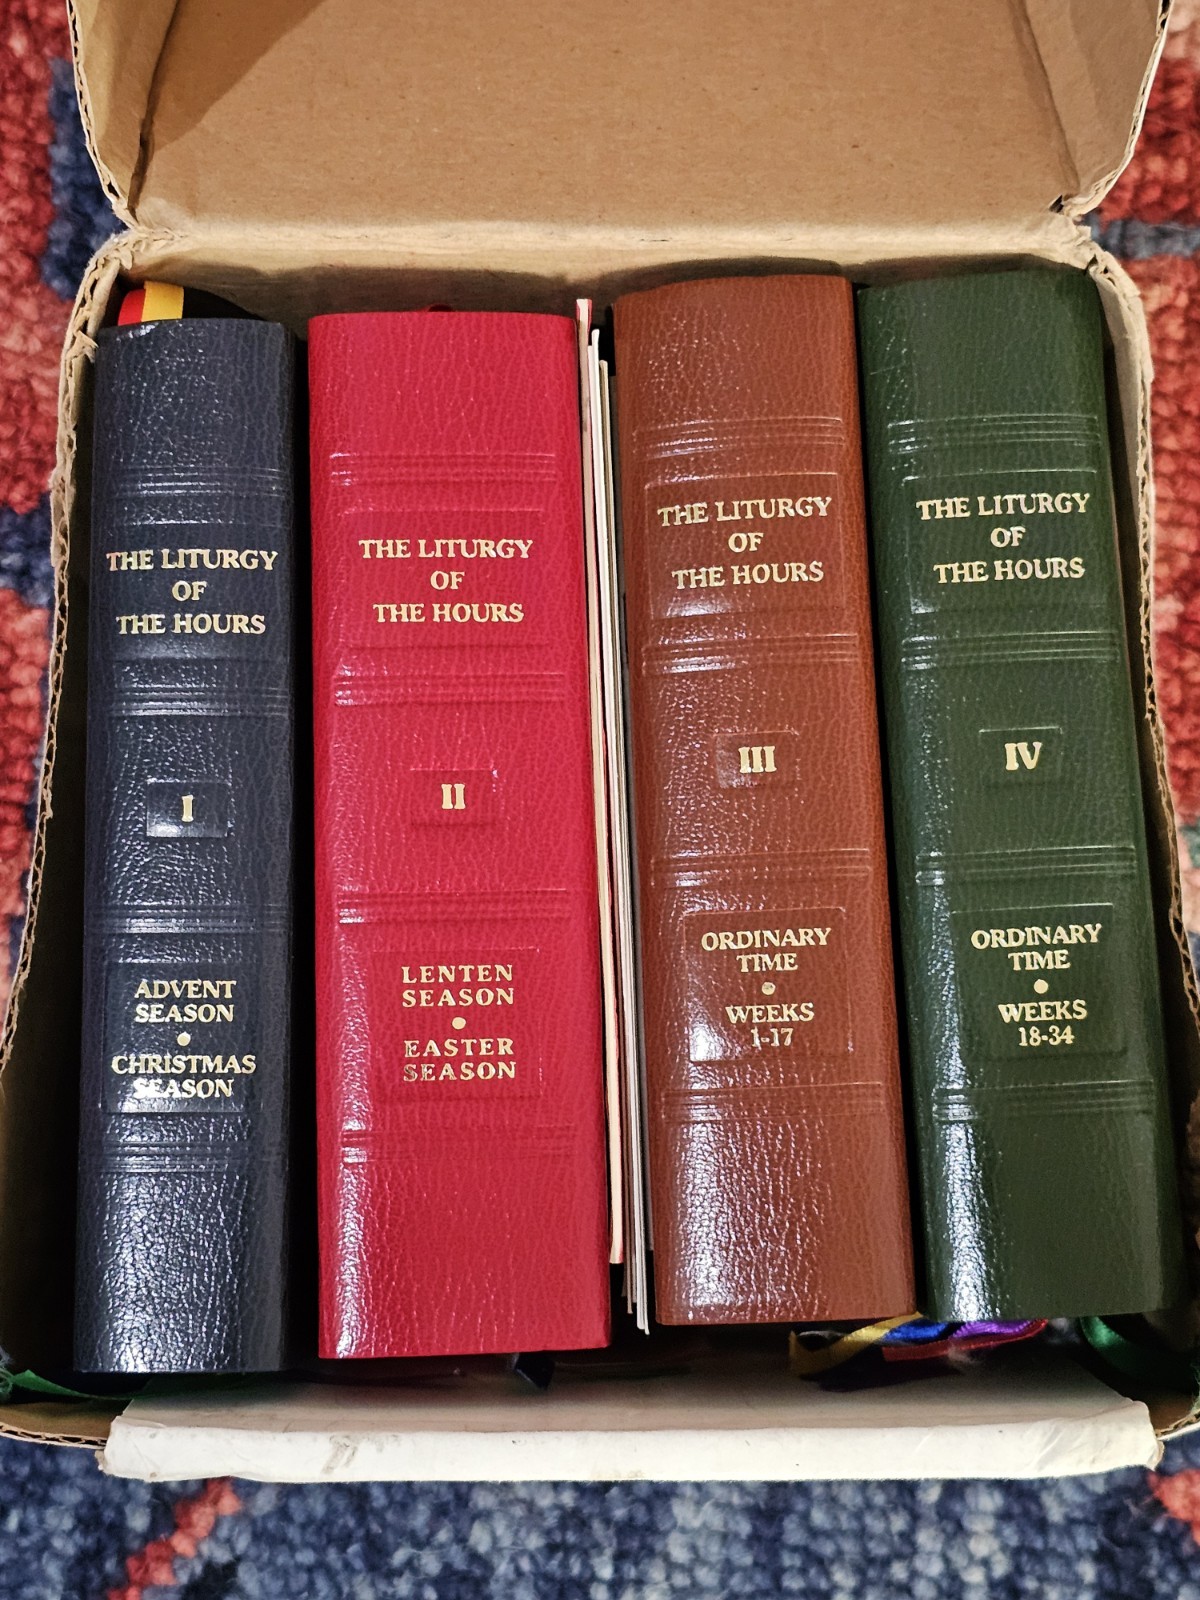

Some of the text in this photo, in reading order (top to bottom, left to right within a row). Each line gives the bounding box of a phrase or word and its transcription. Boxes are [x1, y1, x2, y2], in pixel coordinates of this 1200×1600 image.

[657, 496, 832, 527] THE LITURGY
[916, 492, 1090, 521] THE LITURGY
[728, 532, 764, 553] OF
[990, 526, 1026, 548] OF
[358, 538, 533, 559] THE LITURGY
[106, 549, 278, 571] THE LITURGY
[933, 557, 1086, 584] THE HOURS
[430, 570, 465, 590] OF
[672, 560, 824, 590] THE HOURS
[172, 580, 207, 601] OF
[372, 602, 525, 623] THE HOURS
[116, 613, 266, 635] THE HOURS
[738, 745, 777, 774] III
[1004, 741, 1042, 771] IV
[441, 783, 466, 810] II
[181, 794, 194, 822] I
[701, 927, 832, 951] ORDINARY
[970, 923, 1102, 950] ORDINARY
[736, 952, 799, 973] TIME
[1008, 949, 1071, 971] TIME
[401, 964, 514, 984] LENTEN
[134, 979, 237, 999] ADVENT
[402, 987, 514, 1008] SEASON
[135, 1003, 235, 1023] SEASON
[725, 1002, 815, 1024] WEEKS
[998, 999, 1088, 1024] WEEKS
[404, 1037, 514, 1058] EASTER
[750, 1026, 794, 1048] 1-17
[1018, 1025, 1075, 1048] 18-34
[111, 1054, 256, 1075] CHRISTMAS
[403, 1060, 517, 1082] SEASON
[132, 1079, 235, 1099] SEASON
